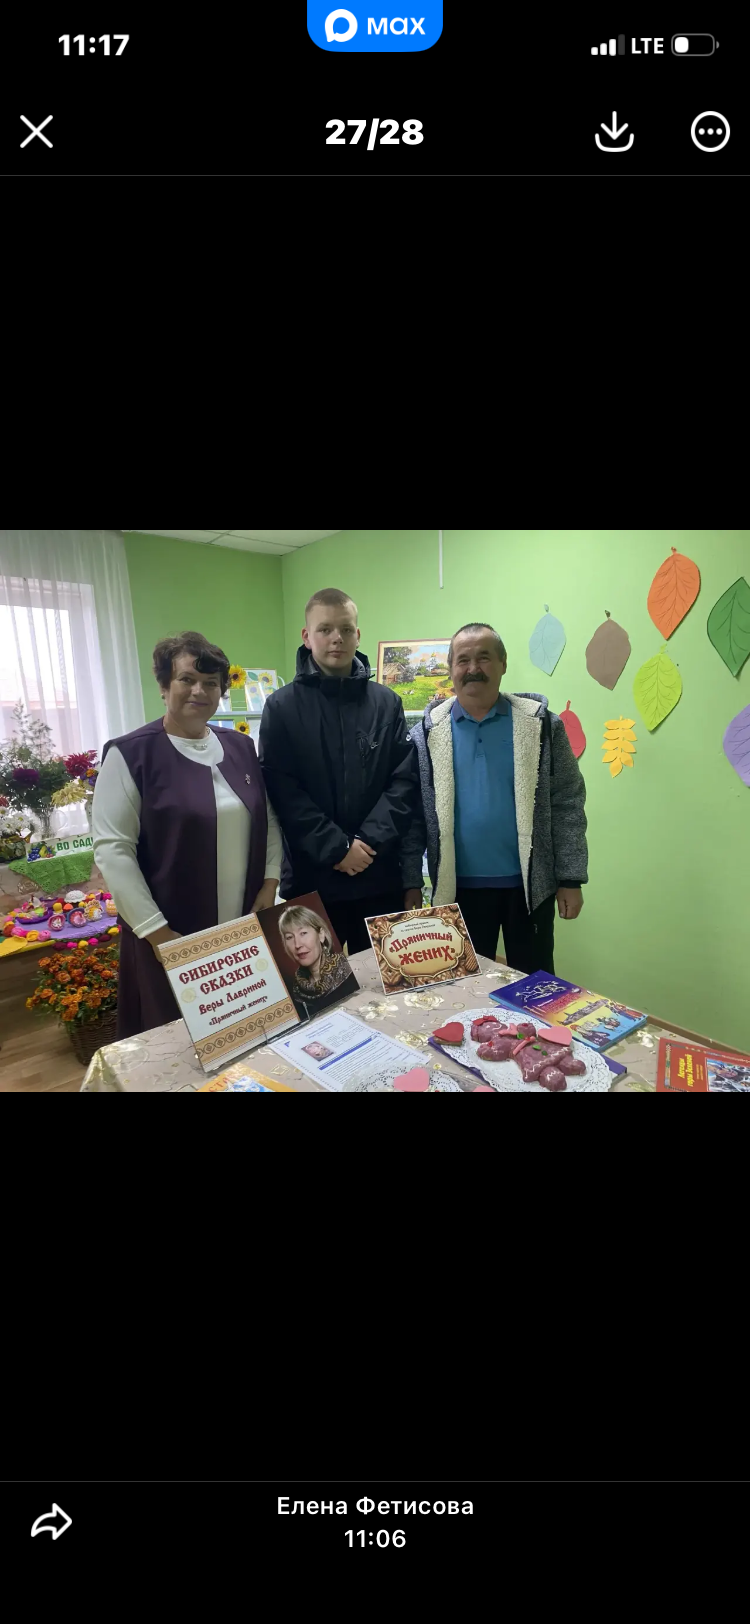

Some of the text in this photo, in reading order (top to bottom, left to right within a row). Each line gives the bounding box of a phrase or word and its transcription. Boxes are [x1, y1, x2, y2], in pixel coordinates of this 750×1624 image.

[56, 841, 70, 851] ВО
[178, 945, 260, 985] СИБИРСКИЕ
[199, 964, 254, 995] СКАЗКИ
[198, 978, 267, 1015] Веры Лавриной
